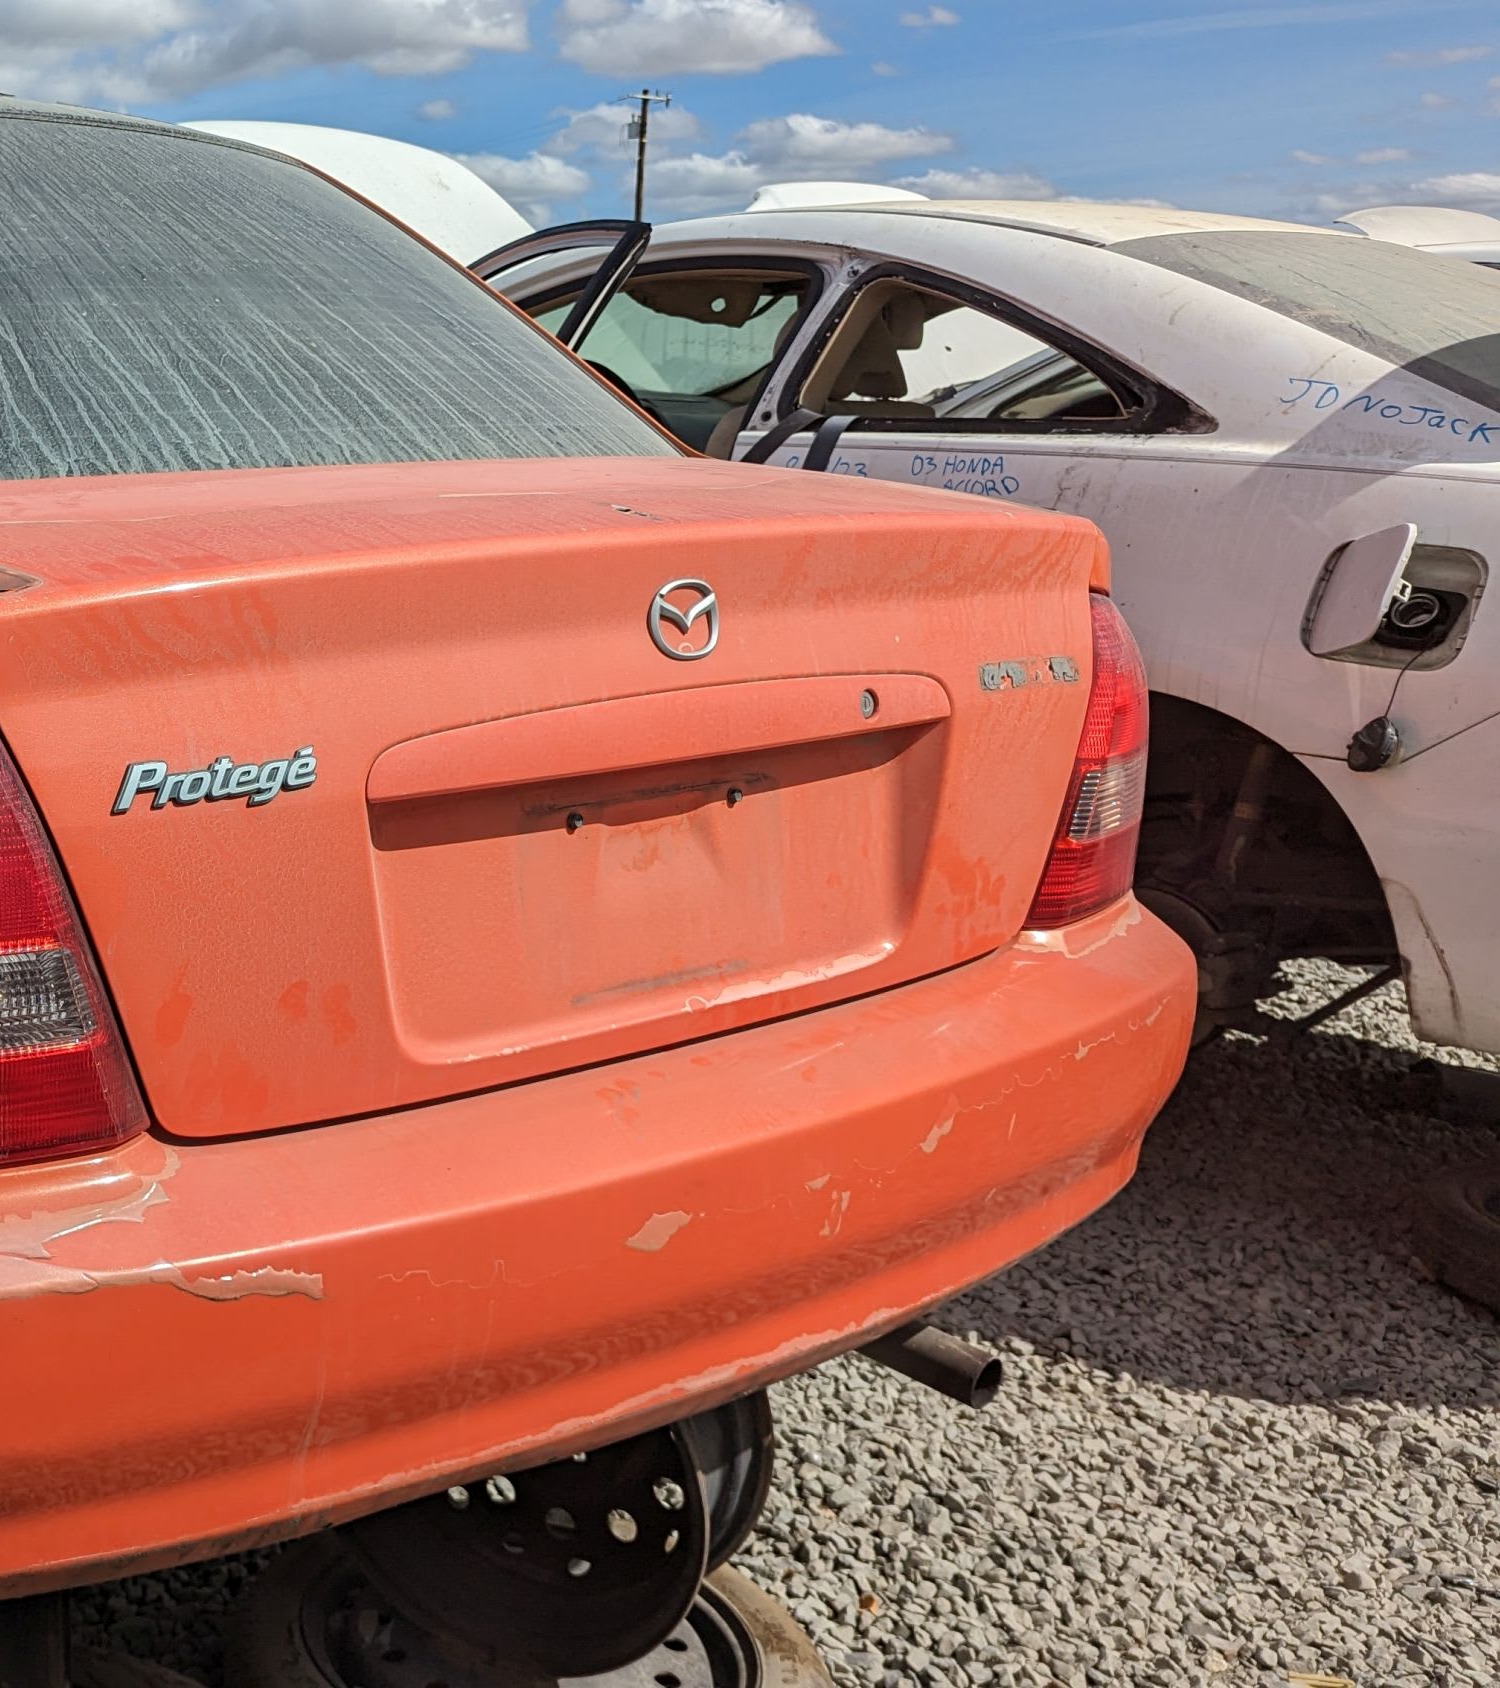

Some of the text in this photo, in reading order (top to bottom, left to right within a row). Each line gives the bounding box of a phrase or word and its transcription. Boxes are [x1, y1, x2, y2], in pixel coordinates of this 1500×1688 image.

[910, 454, 938, 477] 03
[942, 455, 1004, 477] HONDA
[109, 744, 318, 817] Protegé
